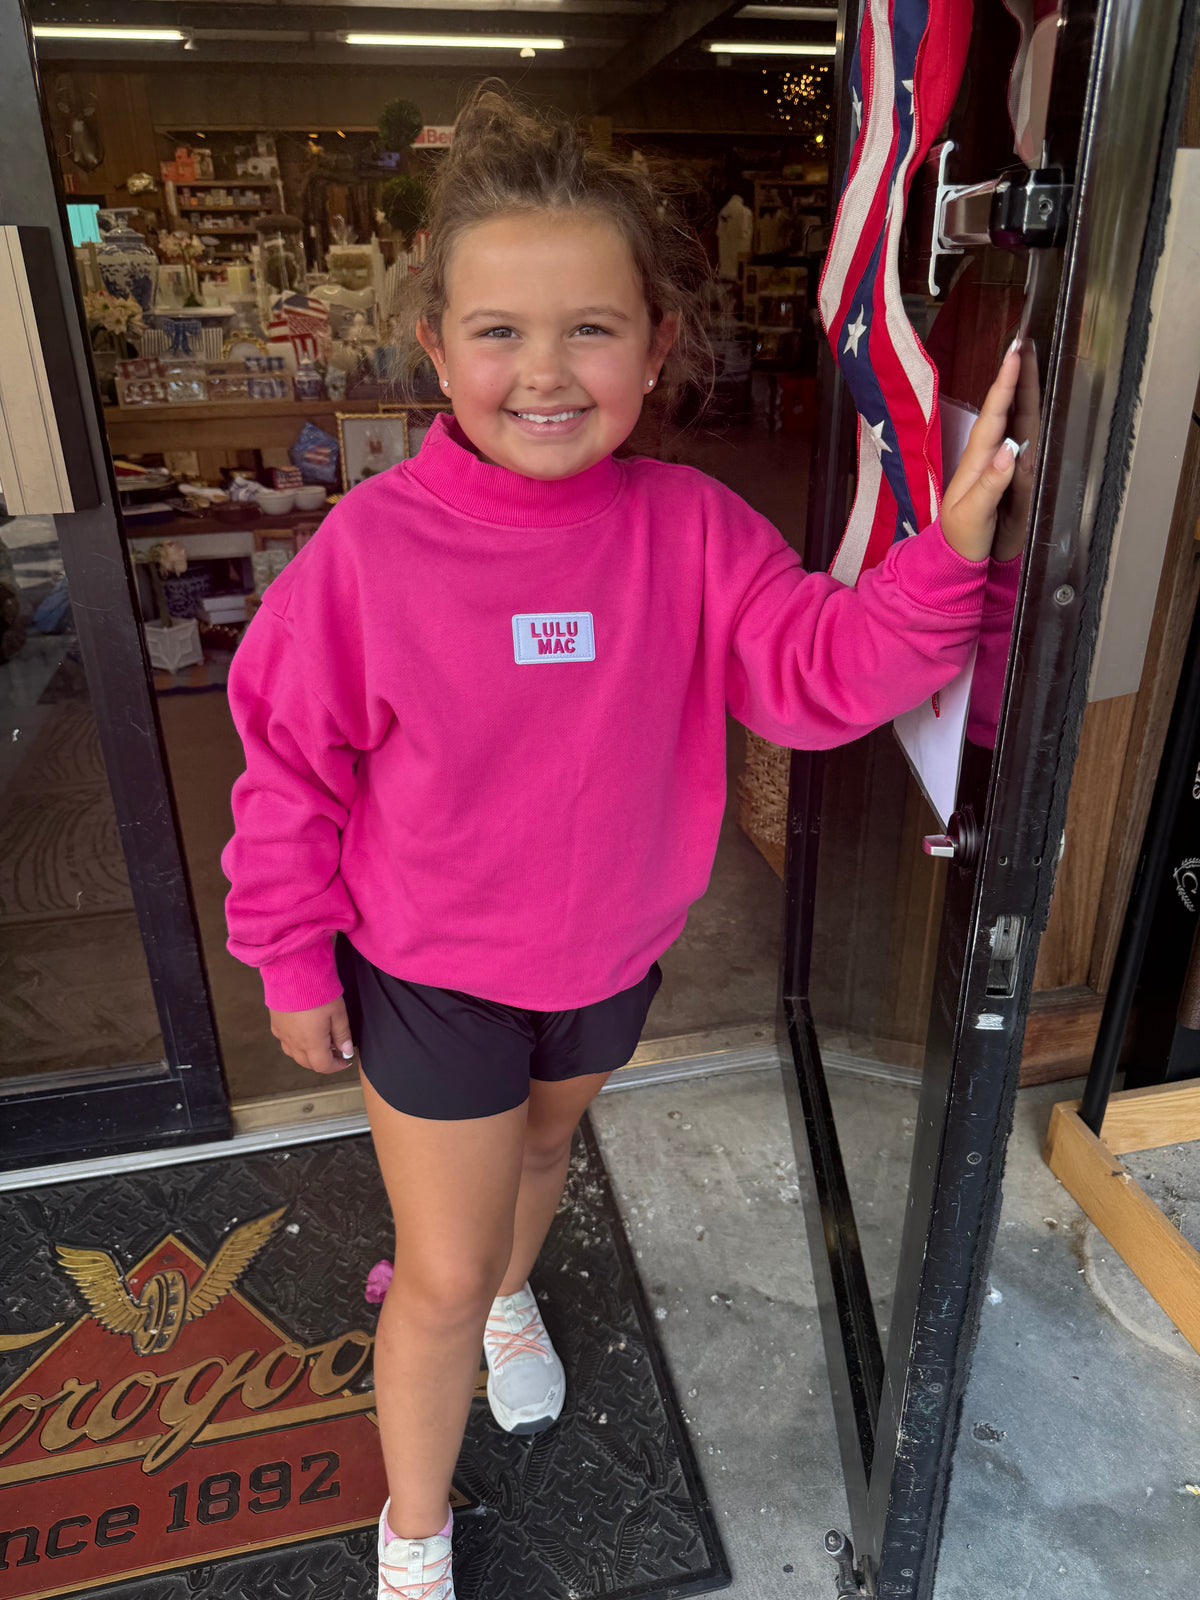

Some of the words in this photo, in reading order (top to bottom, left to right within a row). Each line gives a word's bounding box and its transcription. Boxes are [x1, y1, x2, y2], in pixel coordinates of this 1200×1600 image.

[530, 621, 578, 638] LULU
[537, 638, 576, 655] MAC
[166, 1450, 341, 1533] 1892
